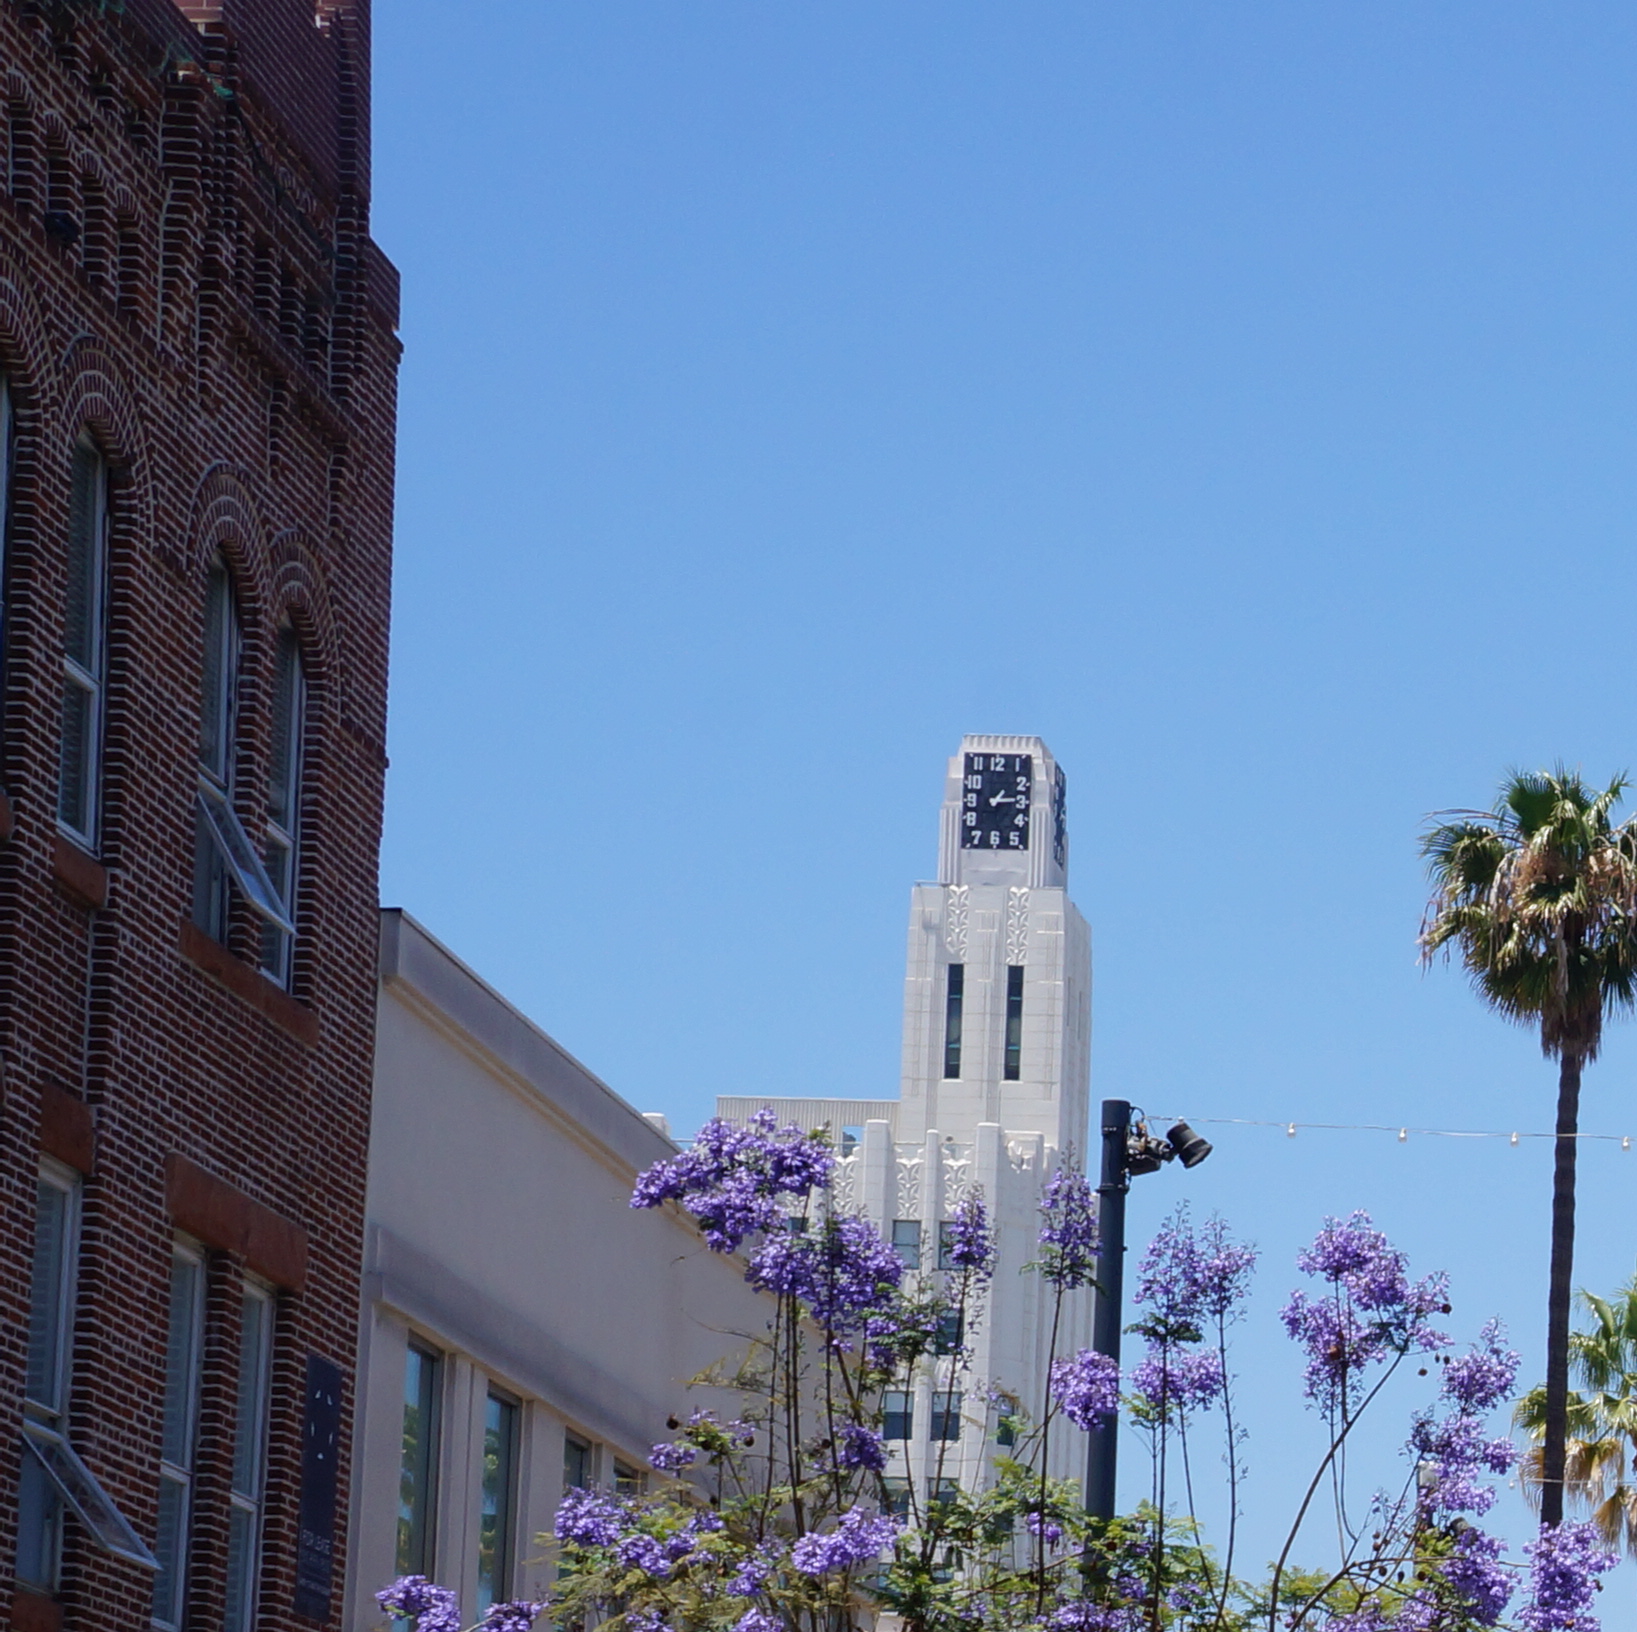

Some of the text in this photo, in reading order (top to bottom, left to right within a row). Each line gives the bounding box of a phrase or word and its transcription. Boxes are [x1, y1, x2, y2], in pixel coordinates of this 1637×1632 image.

[973, 756, 983, 771] 11
[990, 757, 1005, 772] 12
[1015, 757, 1020, 772] 1
[967, 775, 982, 789] 10
[1016, 776, 1027, 791] 2
[967, 793, 977, 807] 9
[1015, 794, 1026, 809] 3
[966, 811, 977, 827] 8
[1013, 813, 1025, 828] 4
[971, 830, 982, 845] 7
[990, 830, 1000, 845] 6
[1009, 831, 1020, 846] 5
